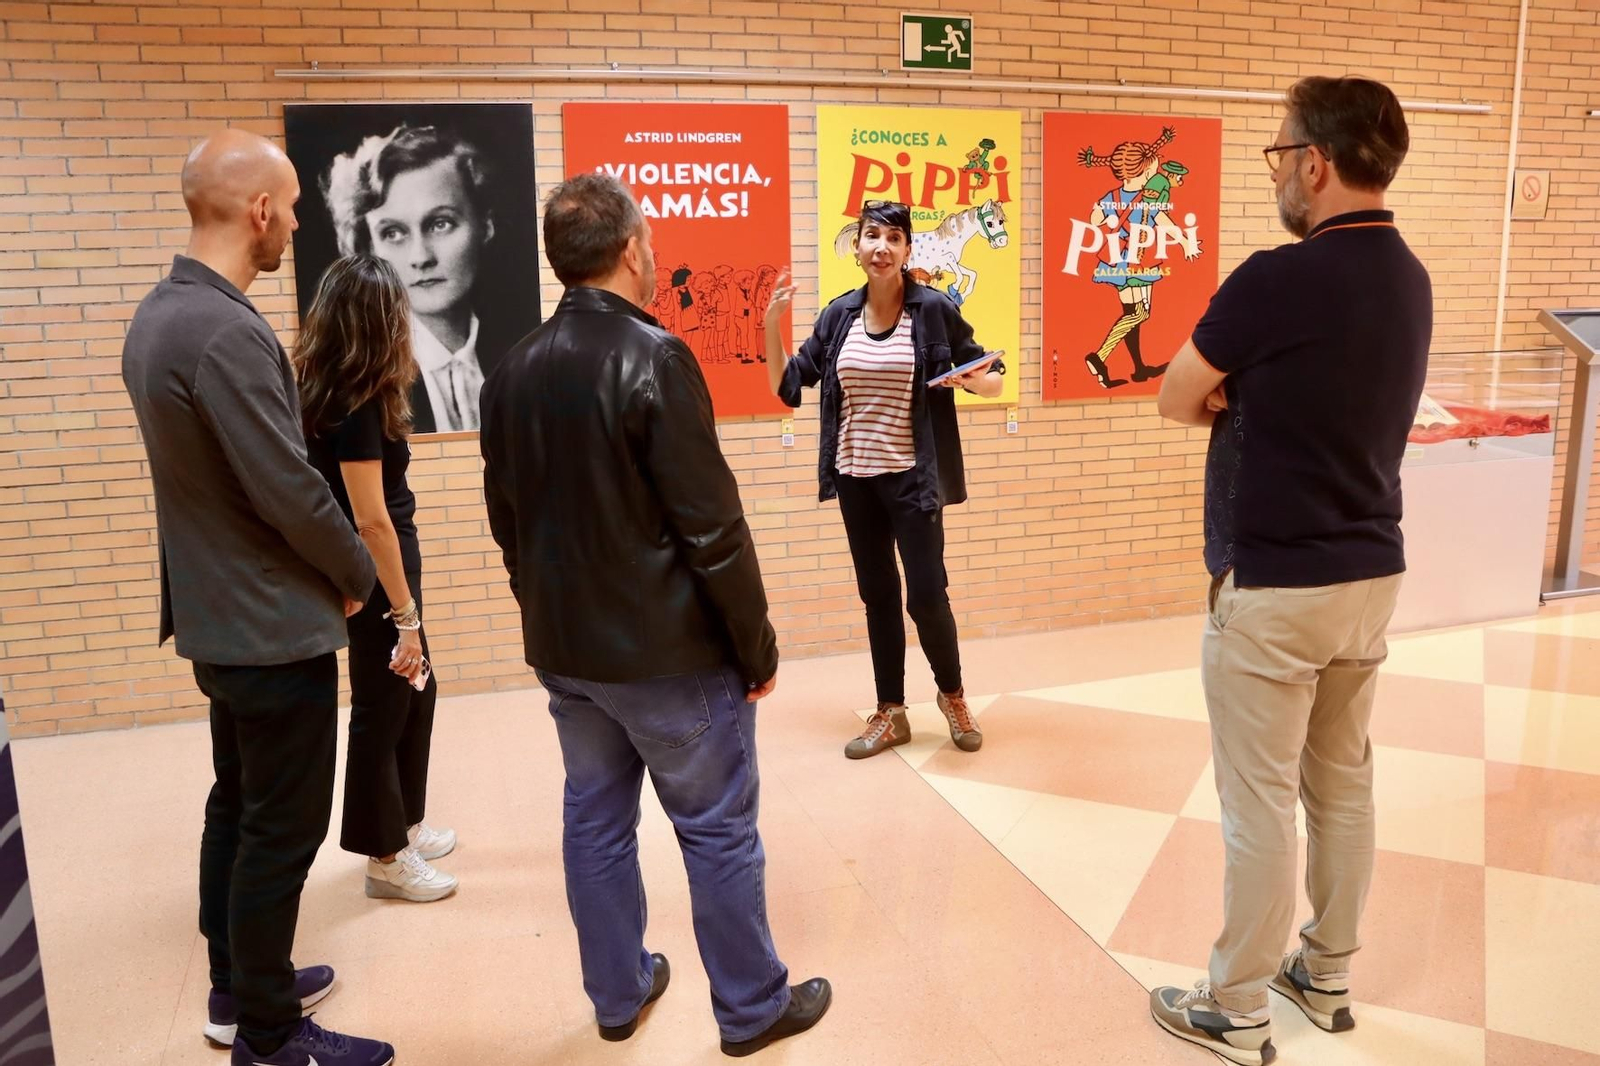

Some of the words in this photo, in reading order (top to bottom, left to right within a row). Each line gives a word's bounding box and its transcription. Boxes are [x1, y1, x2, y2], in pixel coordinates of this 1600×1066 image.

[624, 132, 674, 143] ASTRID
[677, 132, 742, 143] LINDGREN
[851, 128, 929, 147] ¿CONOCES
[936, 134, 948, 146] A
[639, 188, 749, 218] AMÁS!
[1092, 202, 1127, 211] ASTRID
[1129, 202, 1174, 211] LINDGREN
[1093, 266, 1171, 276] CALZASLARGAS
